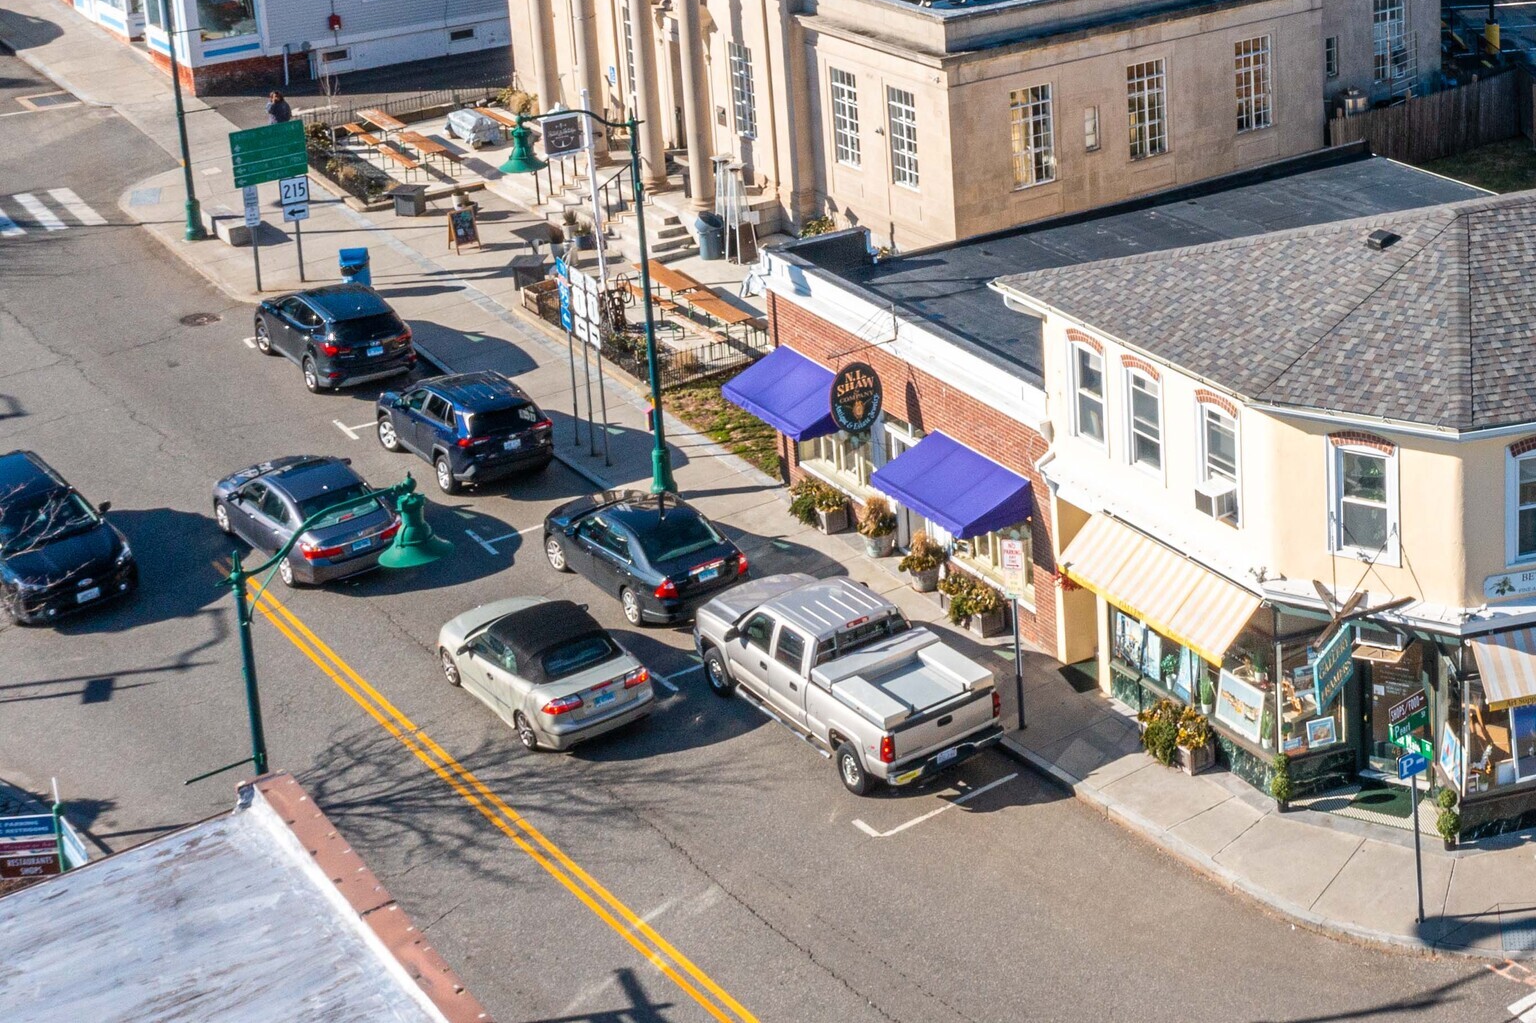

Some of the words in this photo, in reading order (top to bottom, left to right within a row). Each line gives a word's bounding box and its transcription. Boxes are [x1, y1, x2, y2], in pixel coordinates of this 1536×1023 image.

[283, 181, 306, 200] 215
[836, 376, 874, 397] SHAW
[1394, 722, 1411, 739] Pearl
[1401, 758, 1413, 776] P
[7, 856, 54, 867] RESTAURANTS
[20, 865, 43, 875] SHOPS
